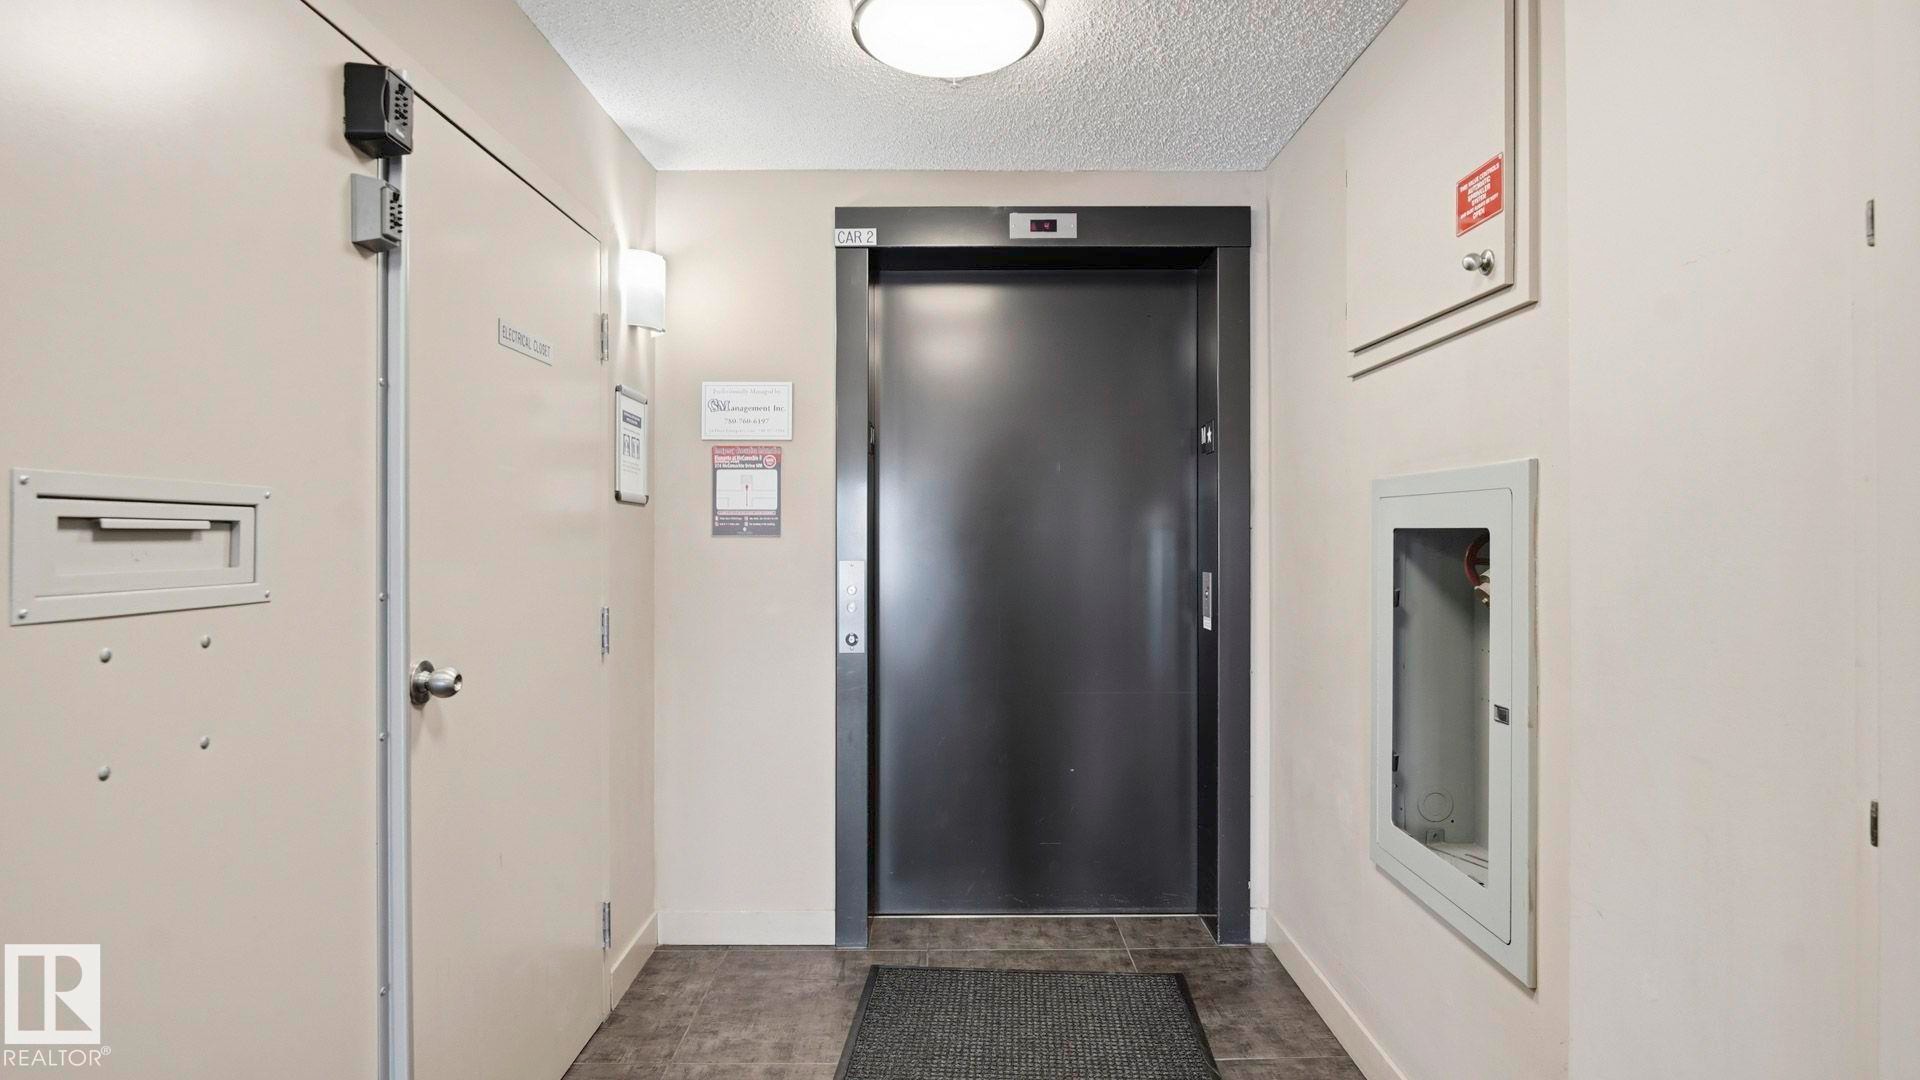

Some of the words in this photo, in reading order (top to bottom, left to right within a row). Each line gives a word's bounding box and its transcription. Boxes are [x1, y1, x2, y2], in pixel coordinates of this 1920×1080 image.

[837, 230, 863, 244] CAR
[866, 230, 874, 243] 2
[502, 324, 532, 350] ELECTRICAL
[532, 339, 551, 360] CLOSET
